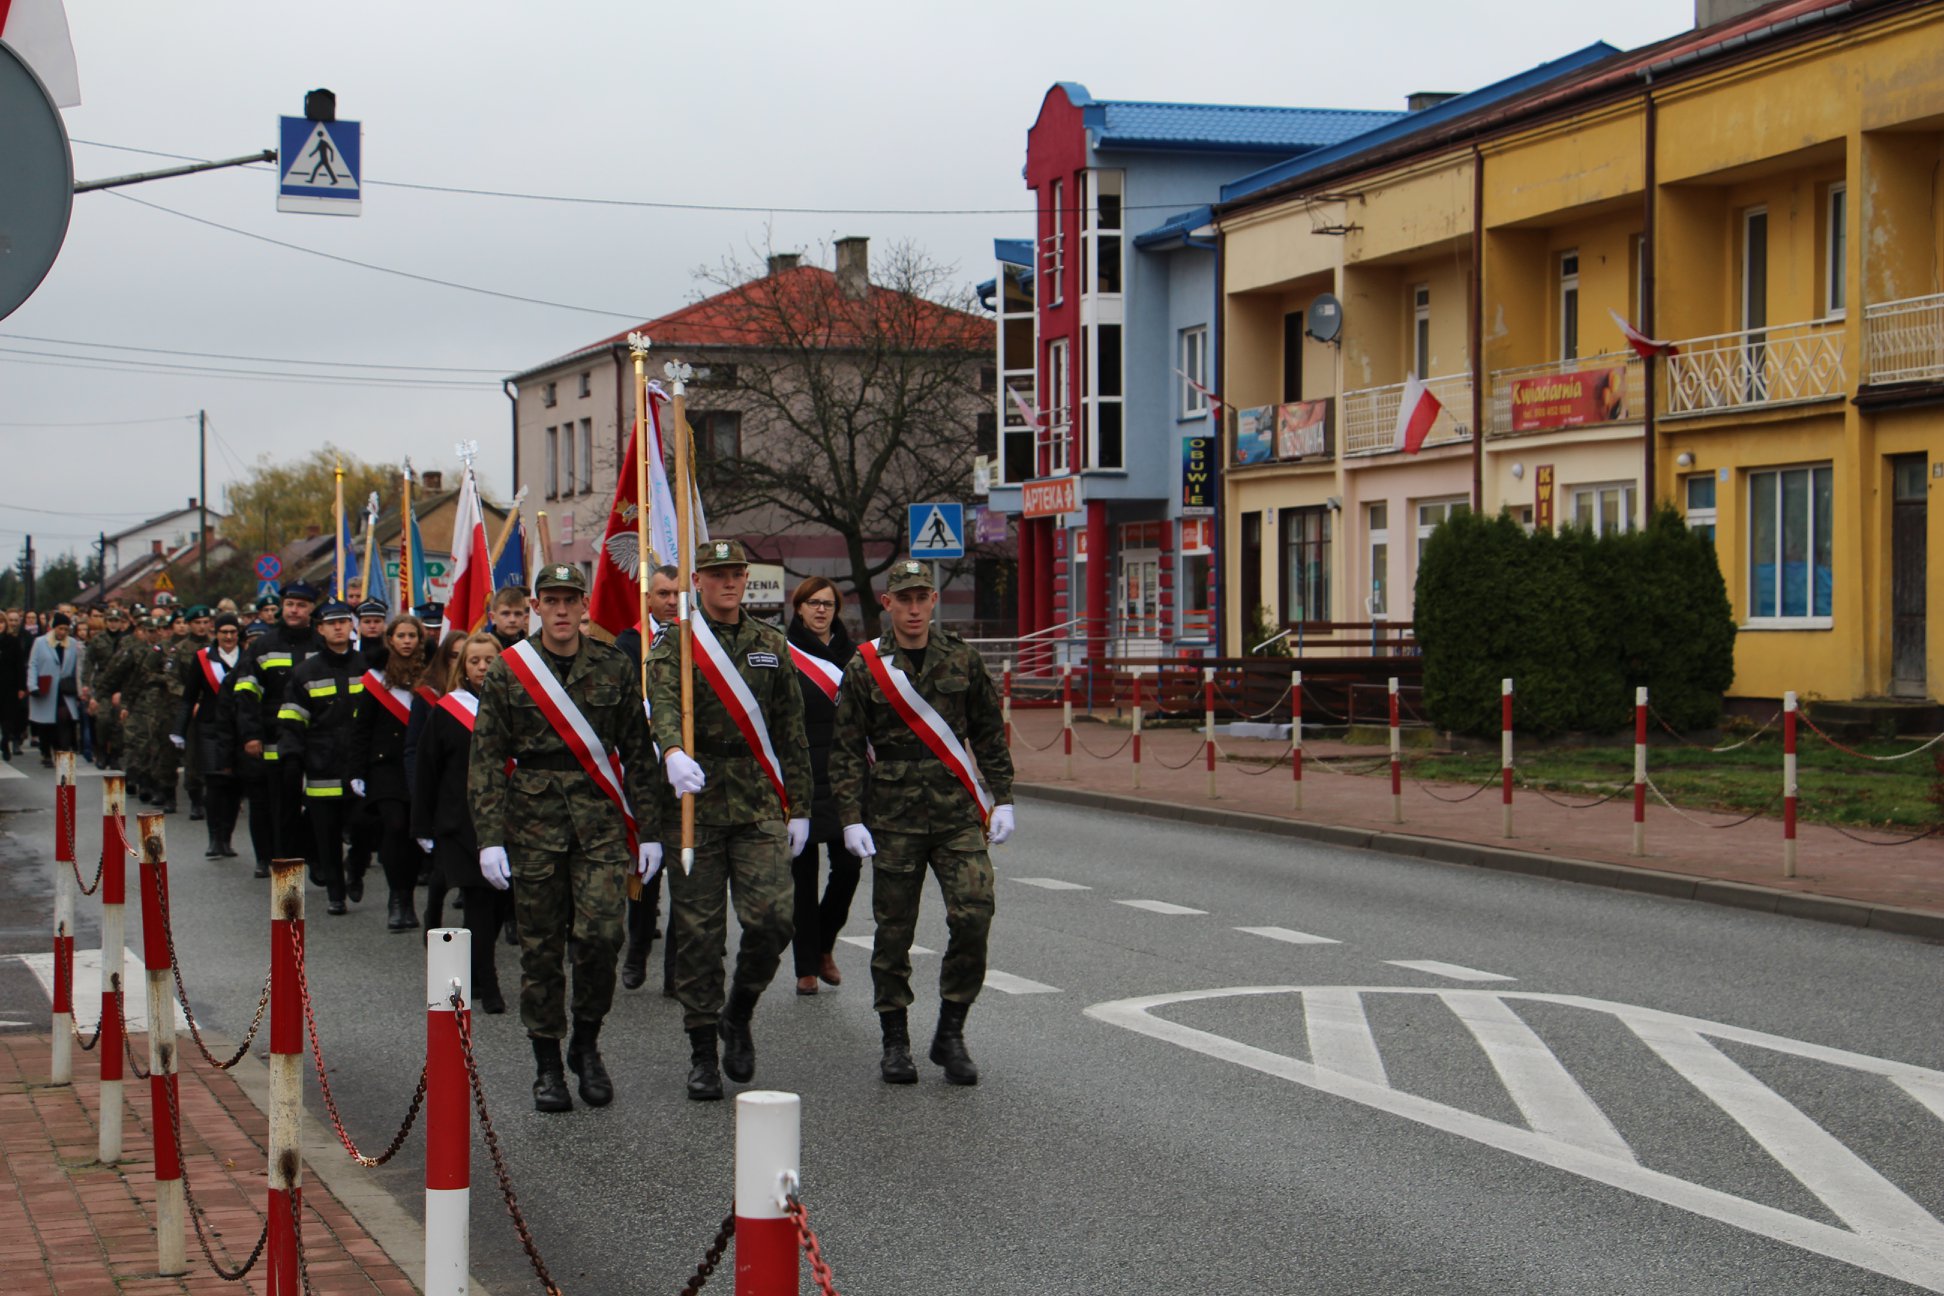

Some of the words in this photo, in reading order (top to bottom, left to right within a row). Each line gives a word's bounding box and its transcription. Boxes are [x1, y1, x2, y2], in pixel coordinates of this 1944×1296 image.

[1512, 377, 1582, 405] Kwiaciarnia
[1187, 438, 1207, 505] OBUWIE
[1024, 487, 1064, 512] APTEKA
